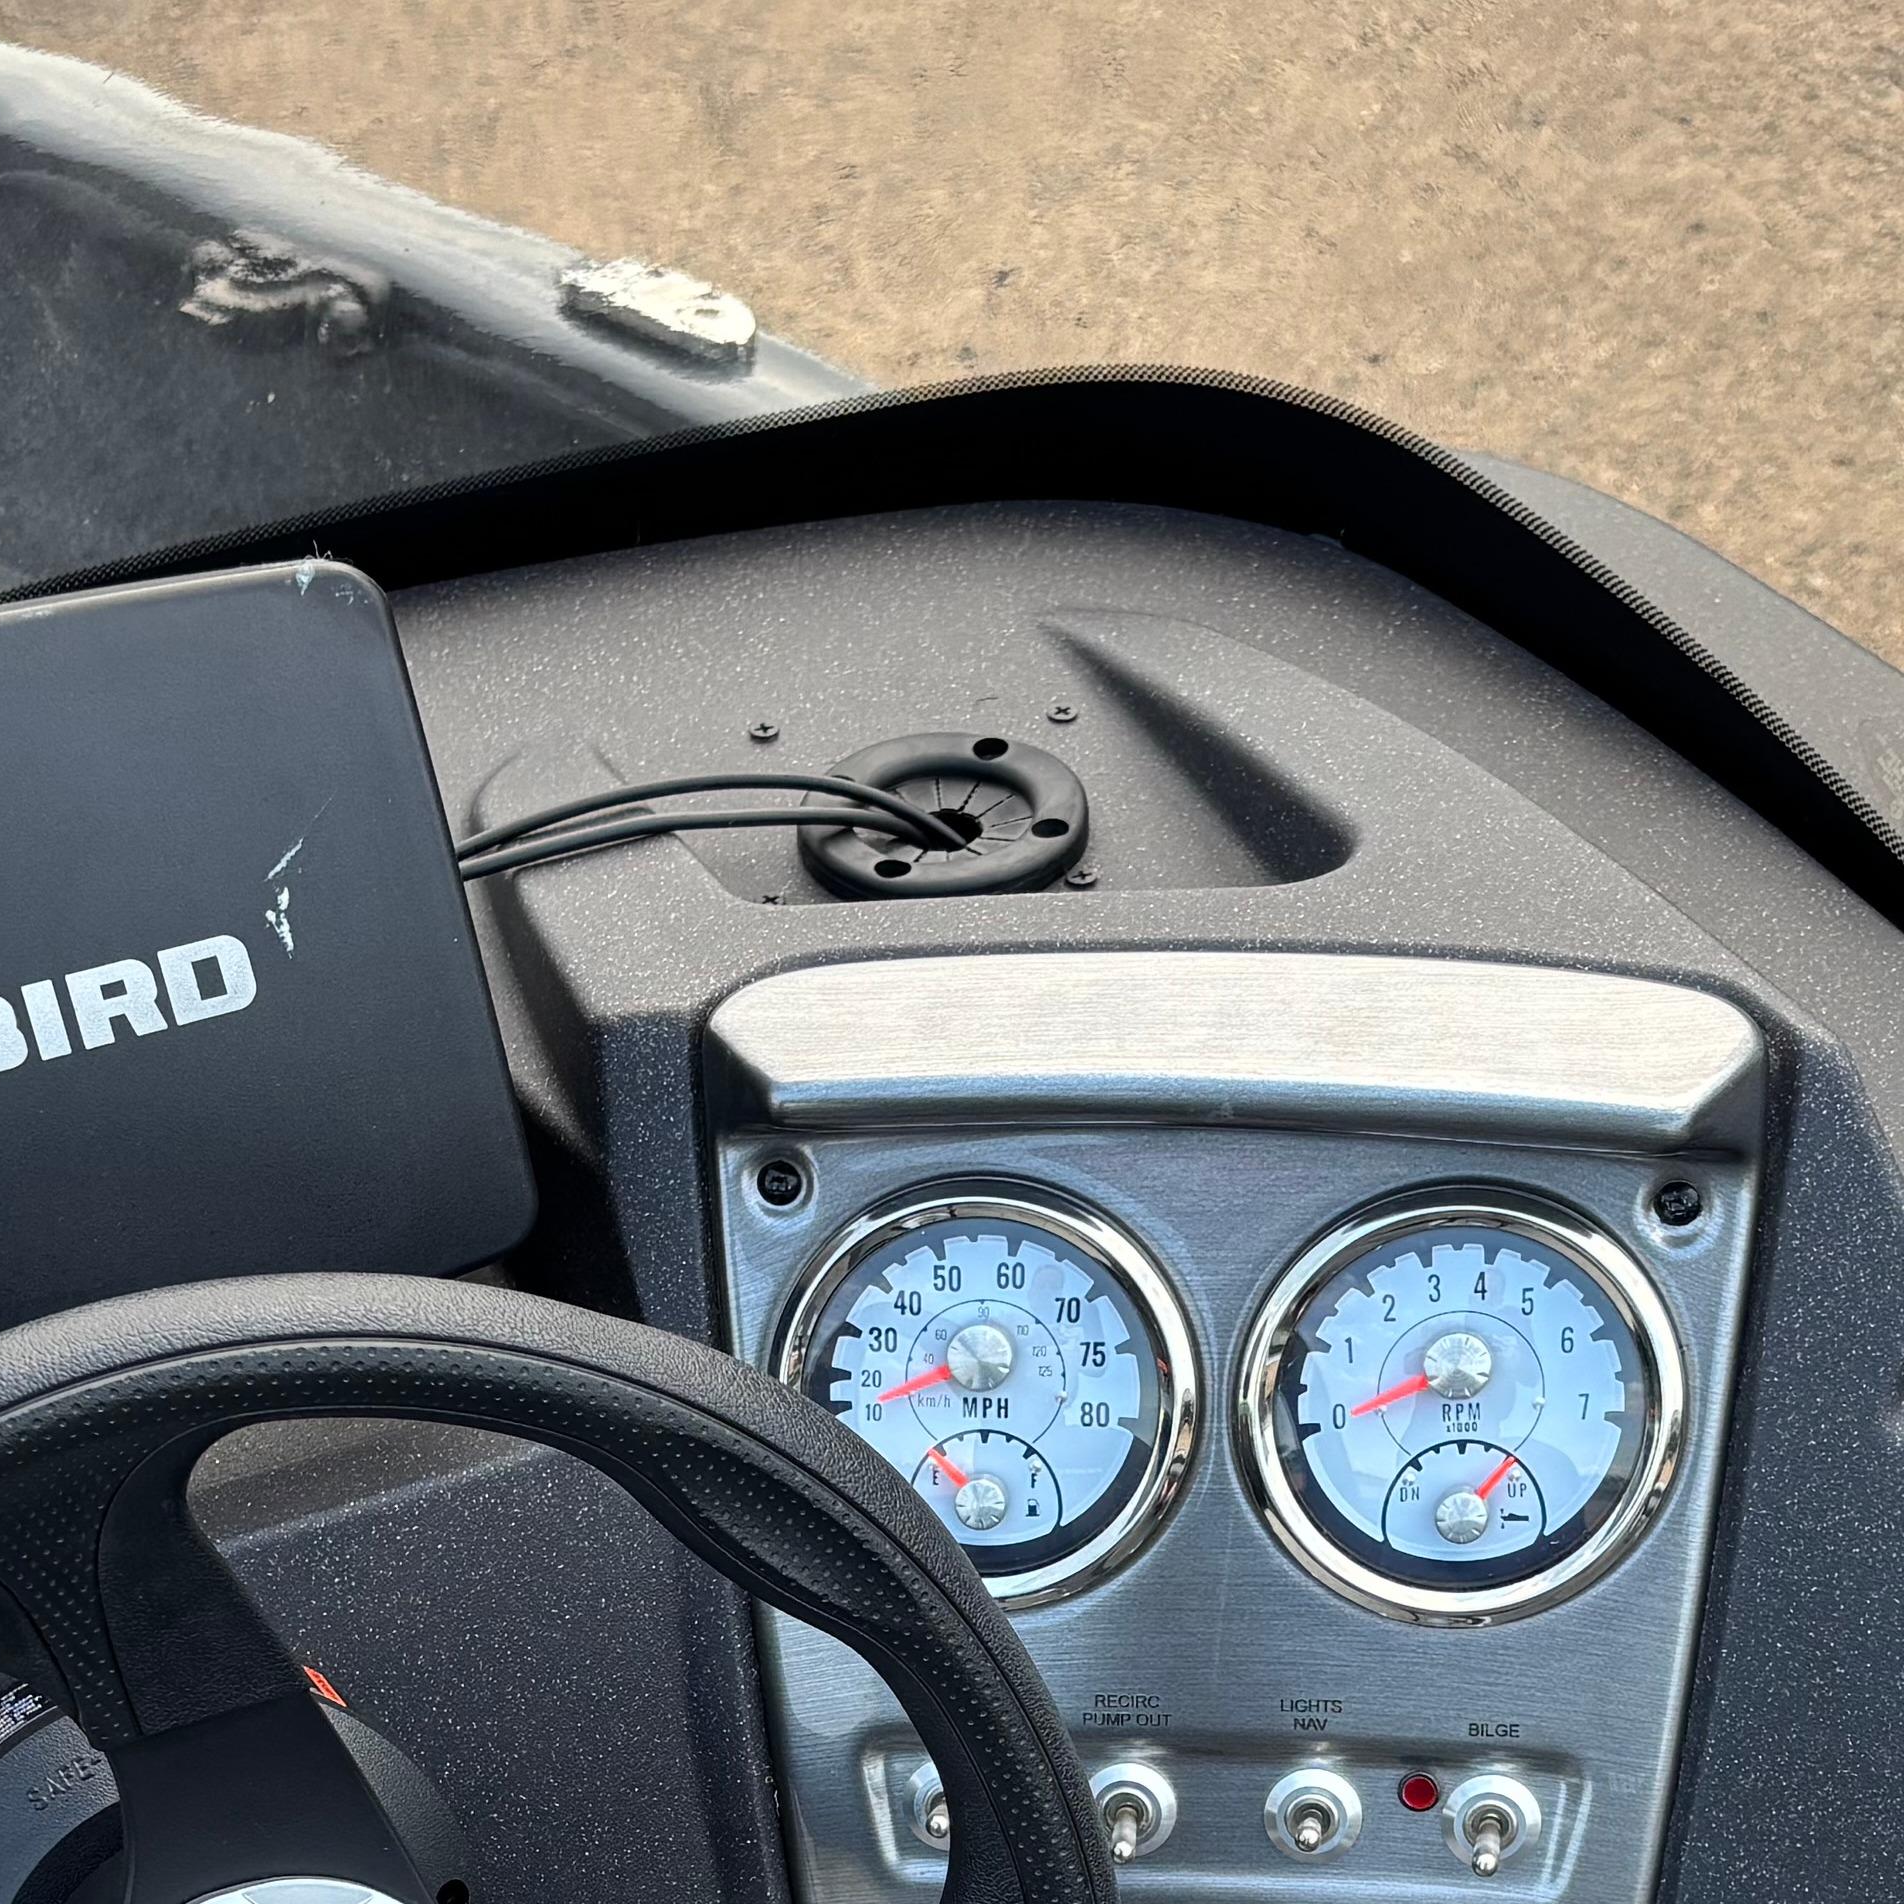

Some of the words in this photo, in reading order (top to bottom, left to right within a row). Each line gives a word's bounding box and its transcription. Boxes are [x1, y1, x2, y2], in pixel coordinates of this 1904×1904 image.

[933, 1265, 961, 1292] 50
[997, 1262, 1025, 1290] 60
[894, 1290, 922, 1316] 40
[1055, 1297, 1081, 1323] 70
[869, 1327, 897, 1353] 30
[923, 1354, 934, 1365] 40
[935, 1329, 947, 1341] 60
[977, 1306, 990, 1320] 90
[1080, 1341, 1105, 1368] 75
[1333, 1404, 1346, 1429] 0
[1345, 1337, 1354, 1364] 1
[1383, 1294, 1397, 1322] 2
[1428, 1274, 1441, 1302] 3
[1474, 1272, 1488, 1300] 4
[1521, 1288, 1534, 1316] 5
[1561, 1327, 1574, 1353] 6
[1578, 1393, 1589, 1420] 7
[861, 1369, 881, 1388] 20
[917, 1392, 951, 1409] km/h
[962, 1398, 1010, 1420] MPH
[866, 1404, 882, 1422] 10
[1080, 1402, 1110, 1427] 80
[1442, 1403, 1481, 1422] RPM
[932, 1469, 940, 1486] E
[1030, 1474, 1038, 1488] F
[1400, 1486, 1420, 1502] DN
[1507, 1483, 1527, 1498] UP
[1096, 1694, 1160, 1709] RECIRC
[1280, 1699, 1343, 1714] LIGHTS
[1082, 1713, 1131, 1727] PUMP
[1136, 1713, 1172, 1728] OUT
[1294, 1717, 1327, 1732] NAV
[1468, 1723, 1520, 1738] BILGE
